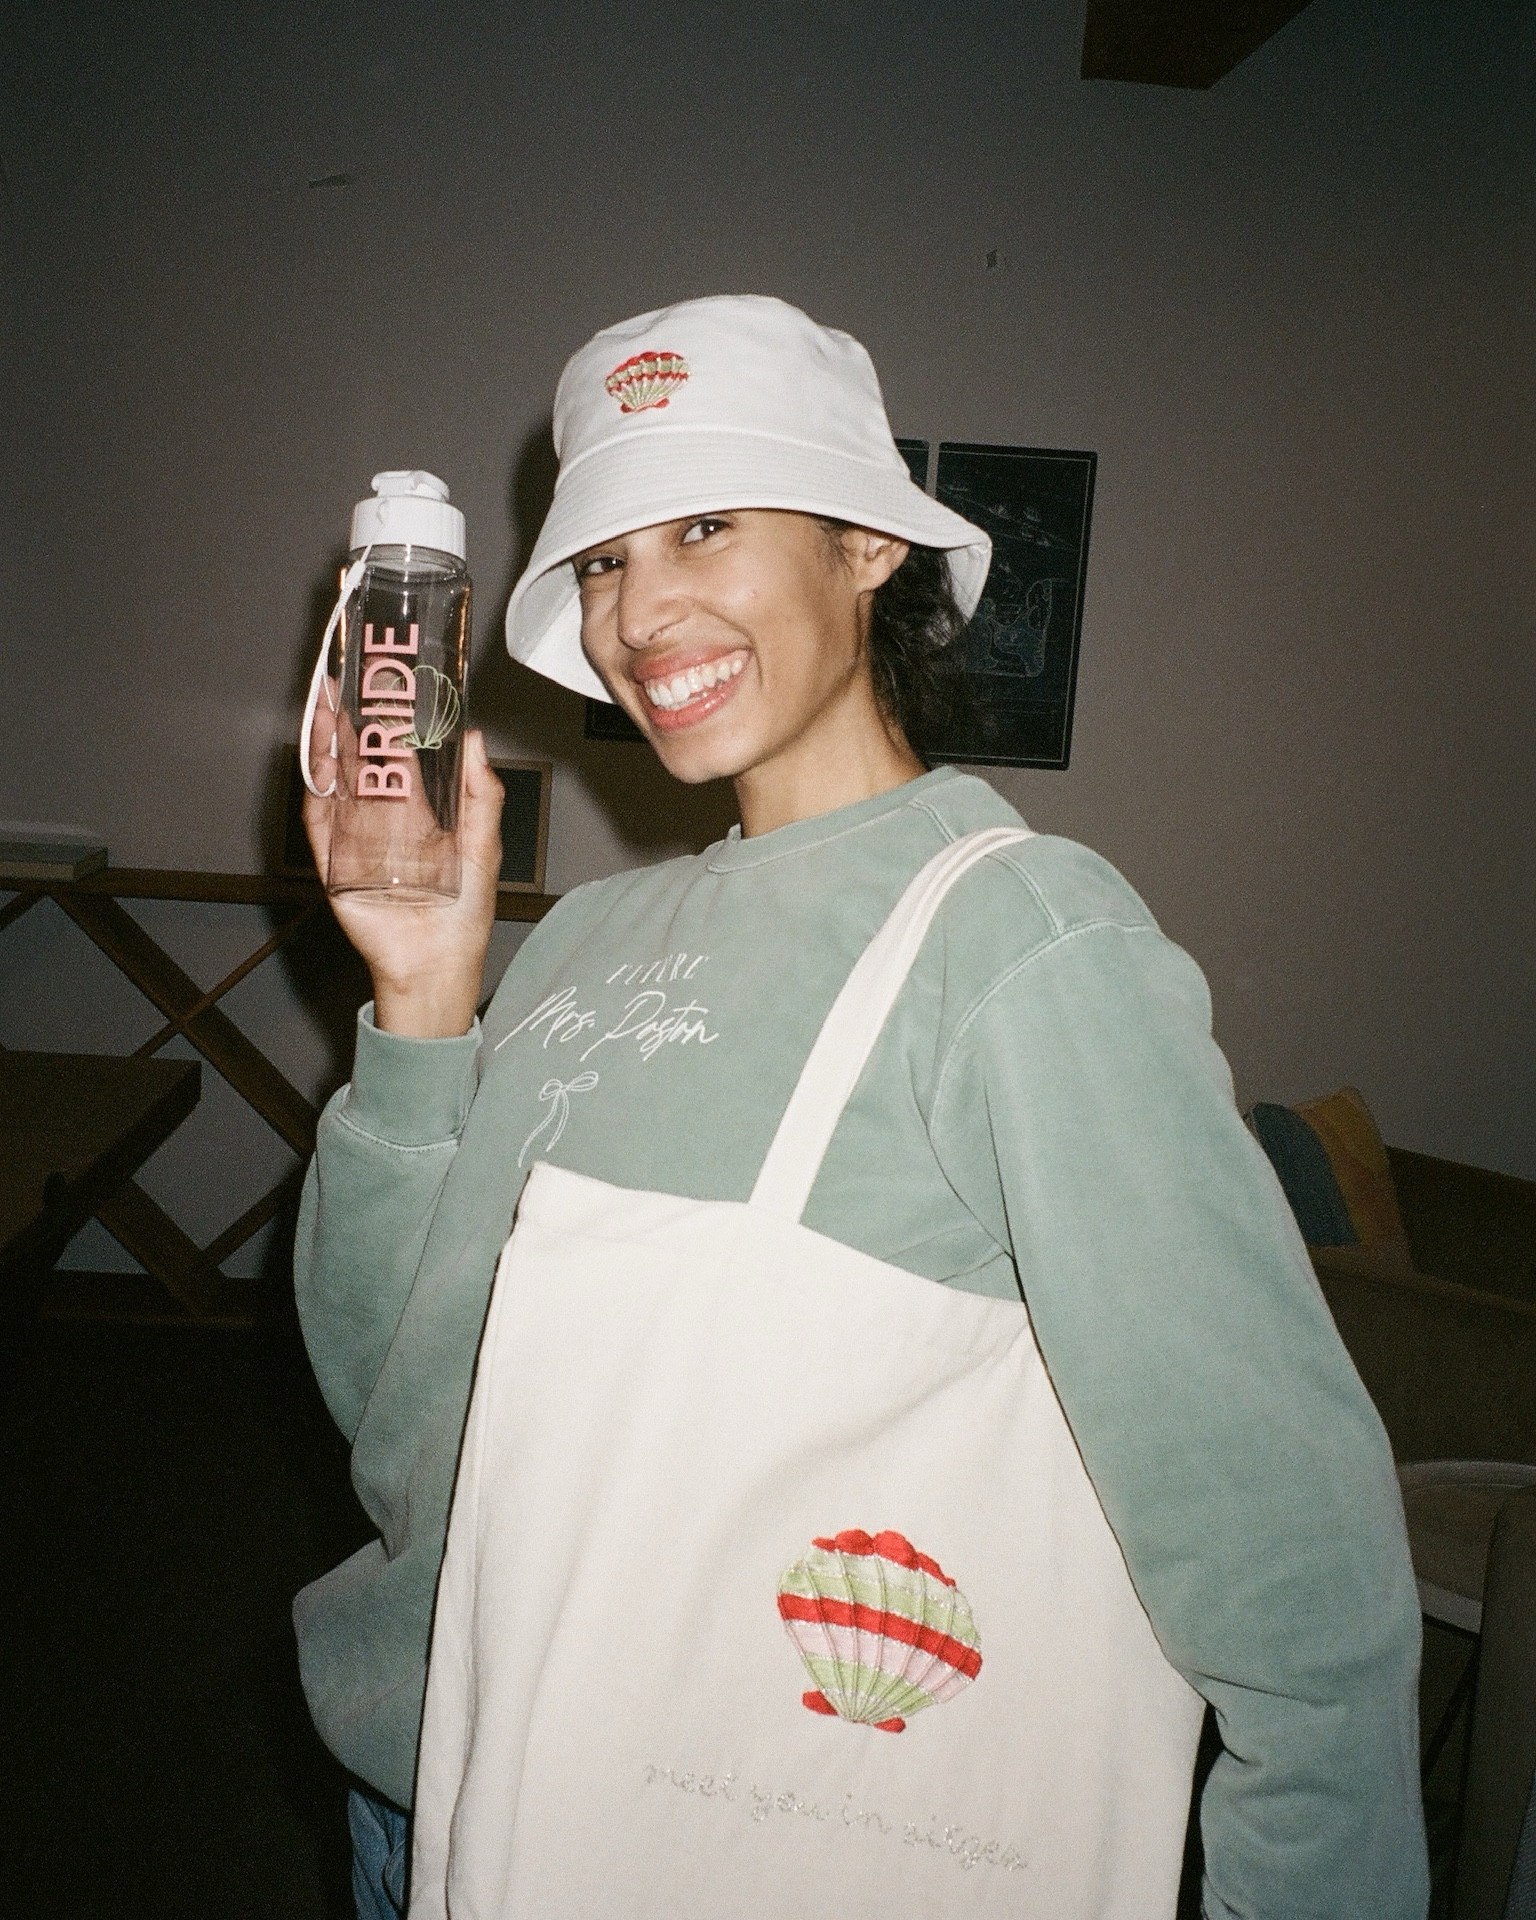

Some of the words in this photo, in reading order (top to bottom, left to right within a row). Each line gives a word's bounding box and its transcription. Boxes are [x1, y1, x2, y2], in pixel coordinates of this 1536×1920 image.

[357, 623, 420, 798] BRIDE
[645, 1764, 739, 1802] meet
[749, 1783, 830, 1824] you
[840, 1792, 893, 1835] in
